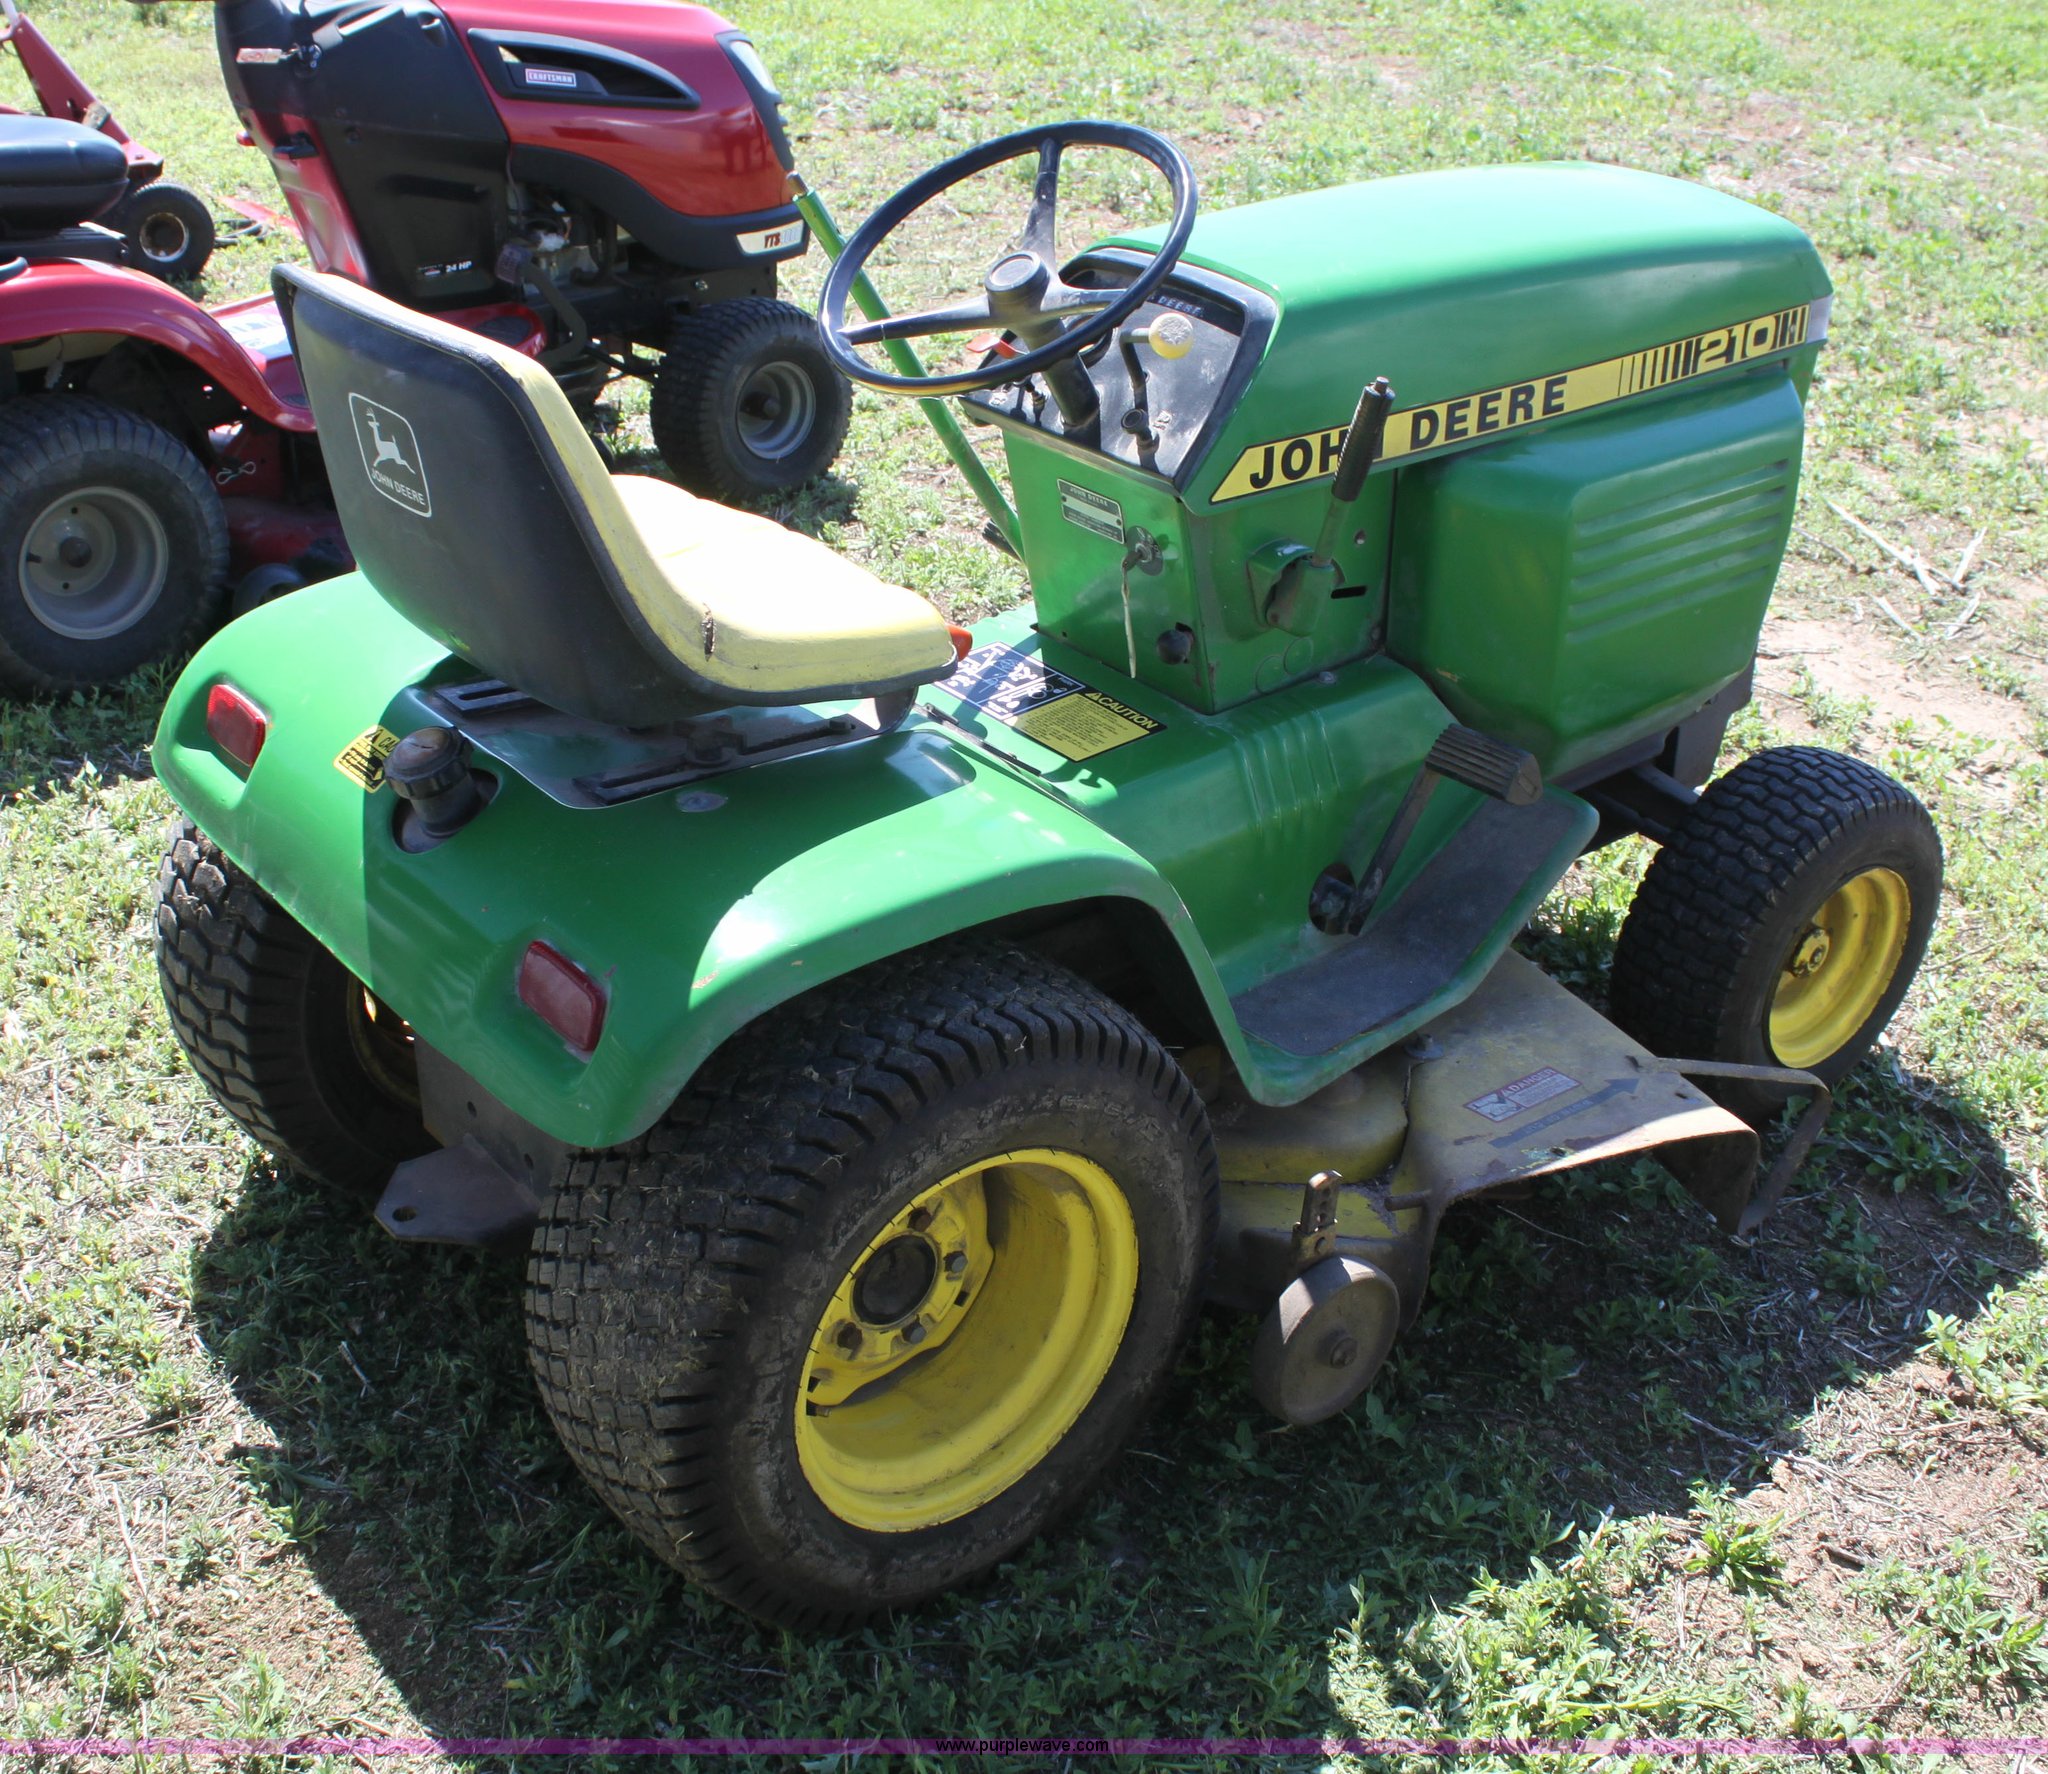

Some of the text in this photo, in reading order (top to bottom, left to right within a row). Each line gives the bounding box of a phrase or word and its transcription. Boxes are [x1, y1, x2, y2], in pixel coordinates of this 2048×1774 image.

[528, 72, 573, 84] CRAFTSMAN
[445, 263, 457, 273] 24
[458, 260, 473, 271] HP
[1697, 315, 1777, 375] 210
[1249, 375, 1568, 490] JOH DEERE
[371, 467, 426, 506] JOHN DEERE
[1098, 696, 1159, 730] CAUTION
[1510, 1068, 1557, 1097] DANGER
